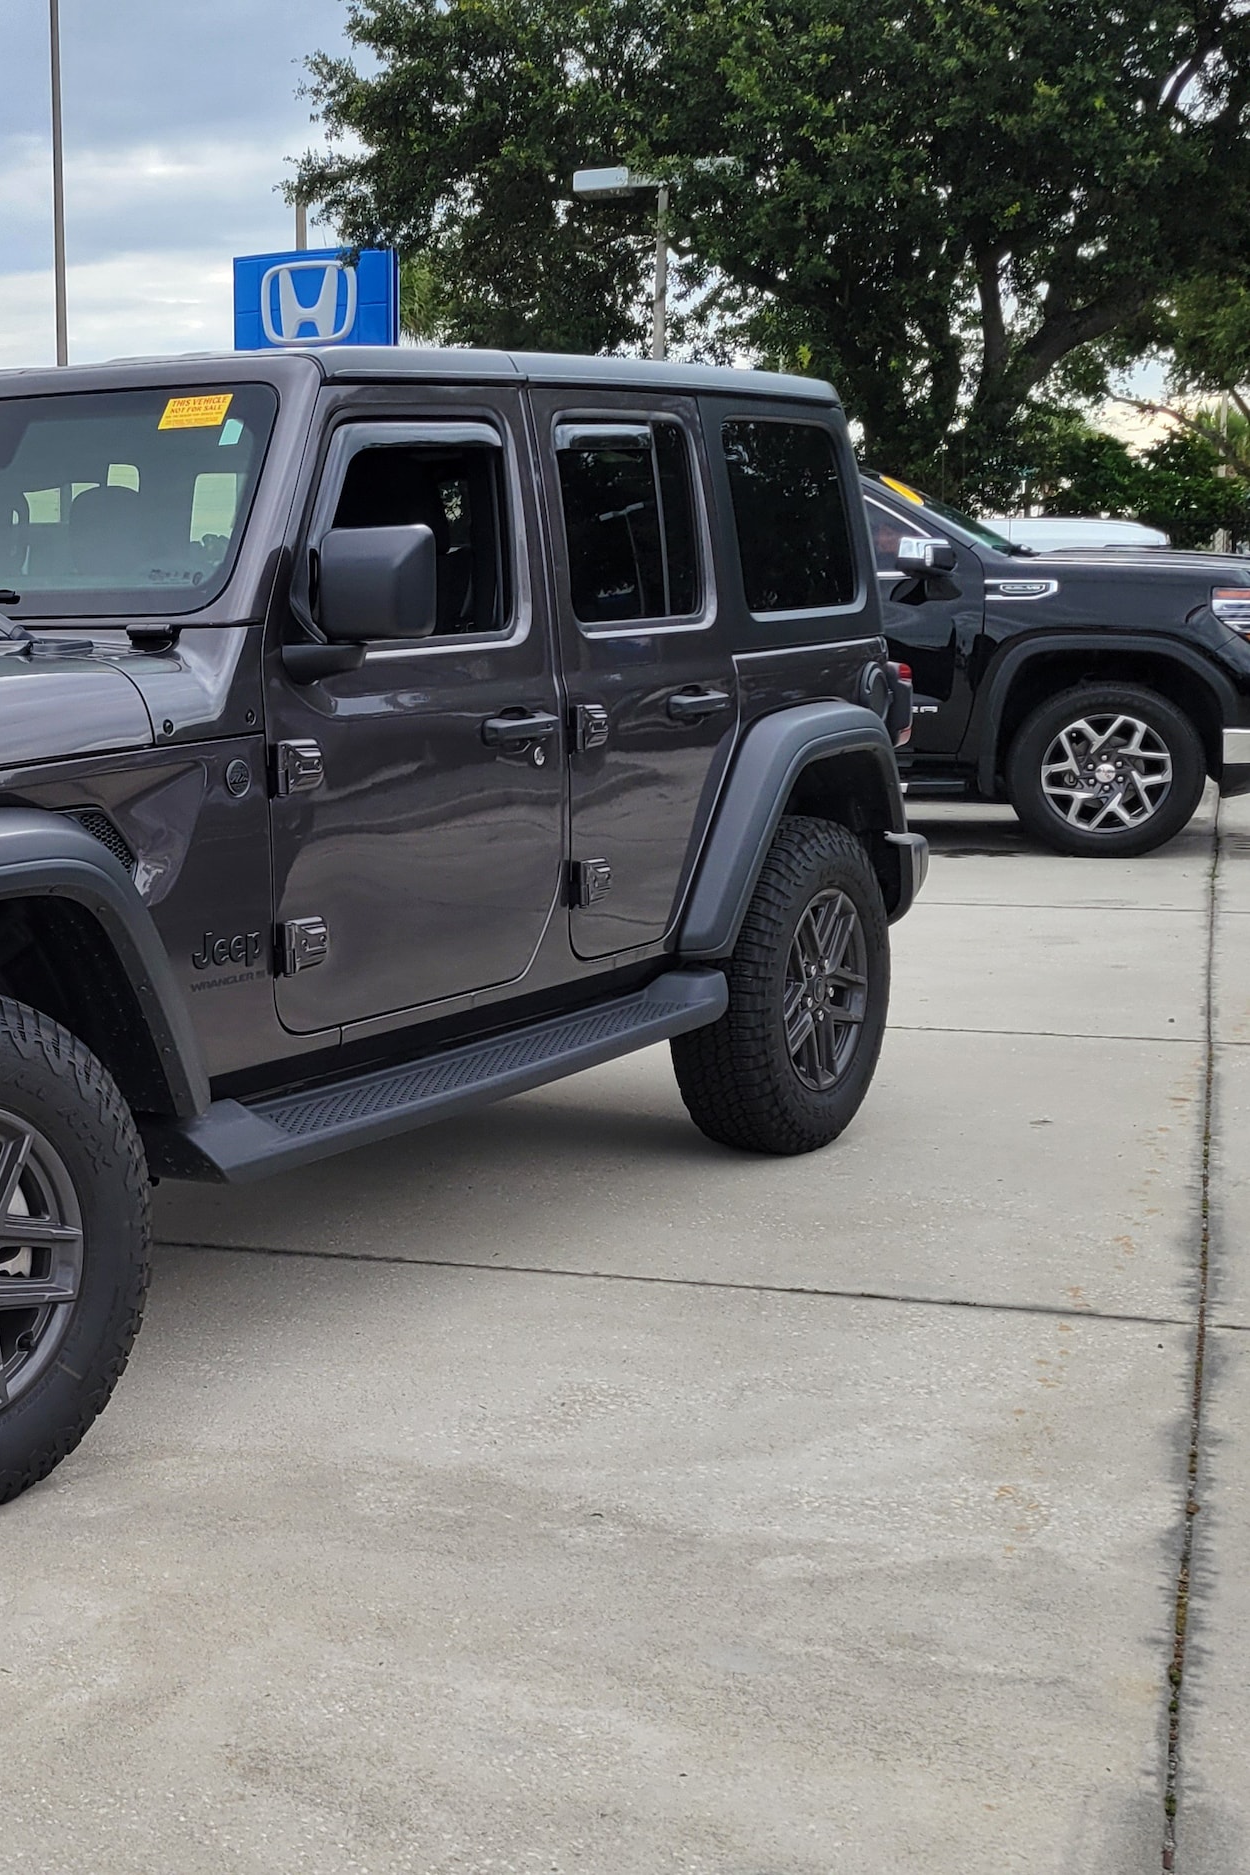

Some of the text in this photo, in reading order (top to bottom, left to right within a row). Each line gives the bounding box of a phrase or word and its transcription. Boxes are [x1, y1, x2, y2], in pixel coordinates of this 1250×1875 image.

[172, 396, 228, 407] THIS VEHICLE
[192, 931, 260, 969] Jeep
[190, 972, 254, 992] WRANGLER
